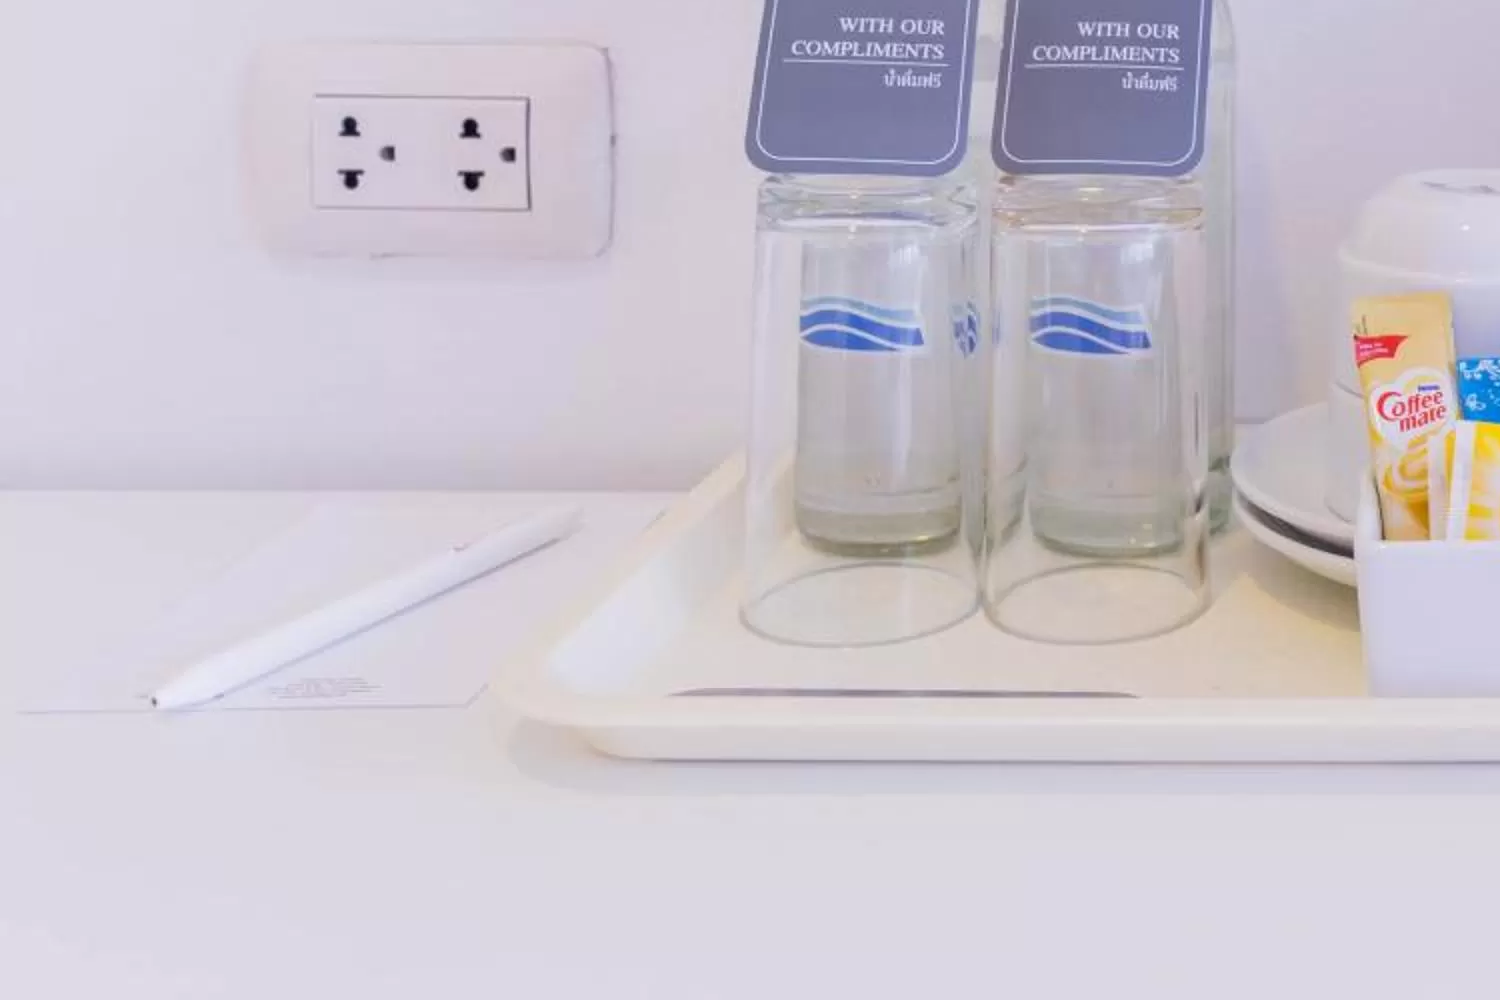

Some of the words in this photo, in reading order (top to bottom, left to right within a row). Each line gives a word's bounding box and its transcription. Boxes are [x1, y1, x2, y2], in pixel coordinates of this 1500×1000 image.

[839, 16, 893, 33] WITH
[900, 19, 945, 36] OUR
[1077, 21, 1130, 37] WITH
[1137, 23, 1179, 40] OUR
[791, 39, 945, 60] COMPLIMENTS
[1032, 45, 1180, 63] COMPLIMENTS
[1376, 391, 1444, 422] Coffee
[1399, 405, 1446, 433] mate
